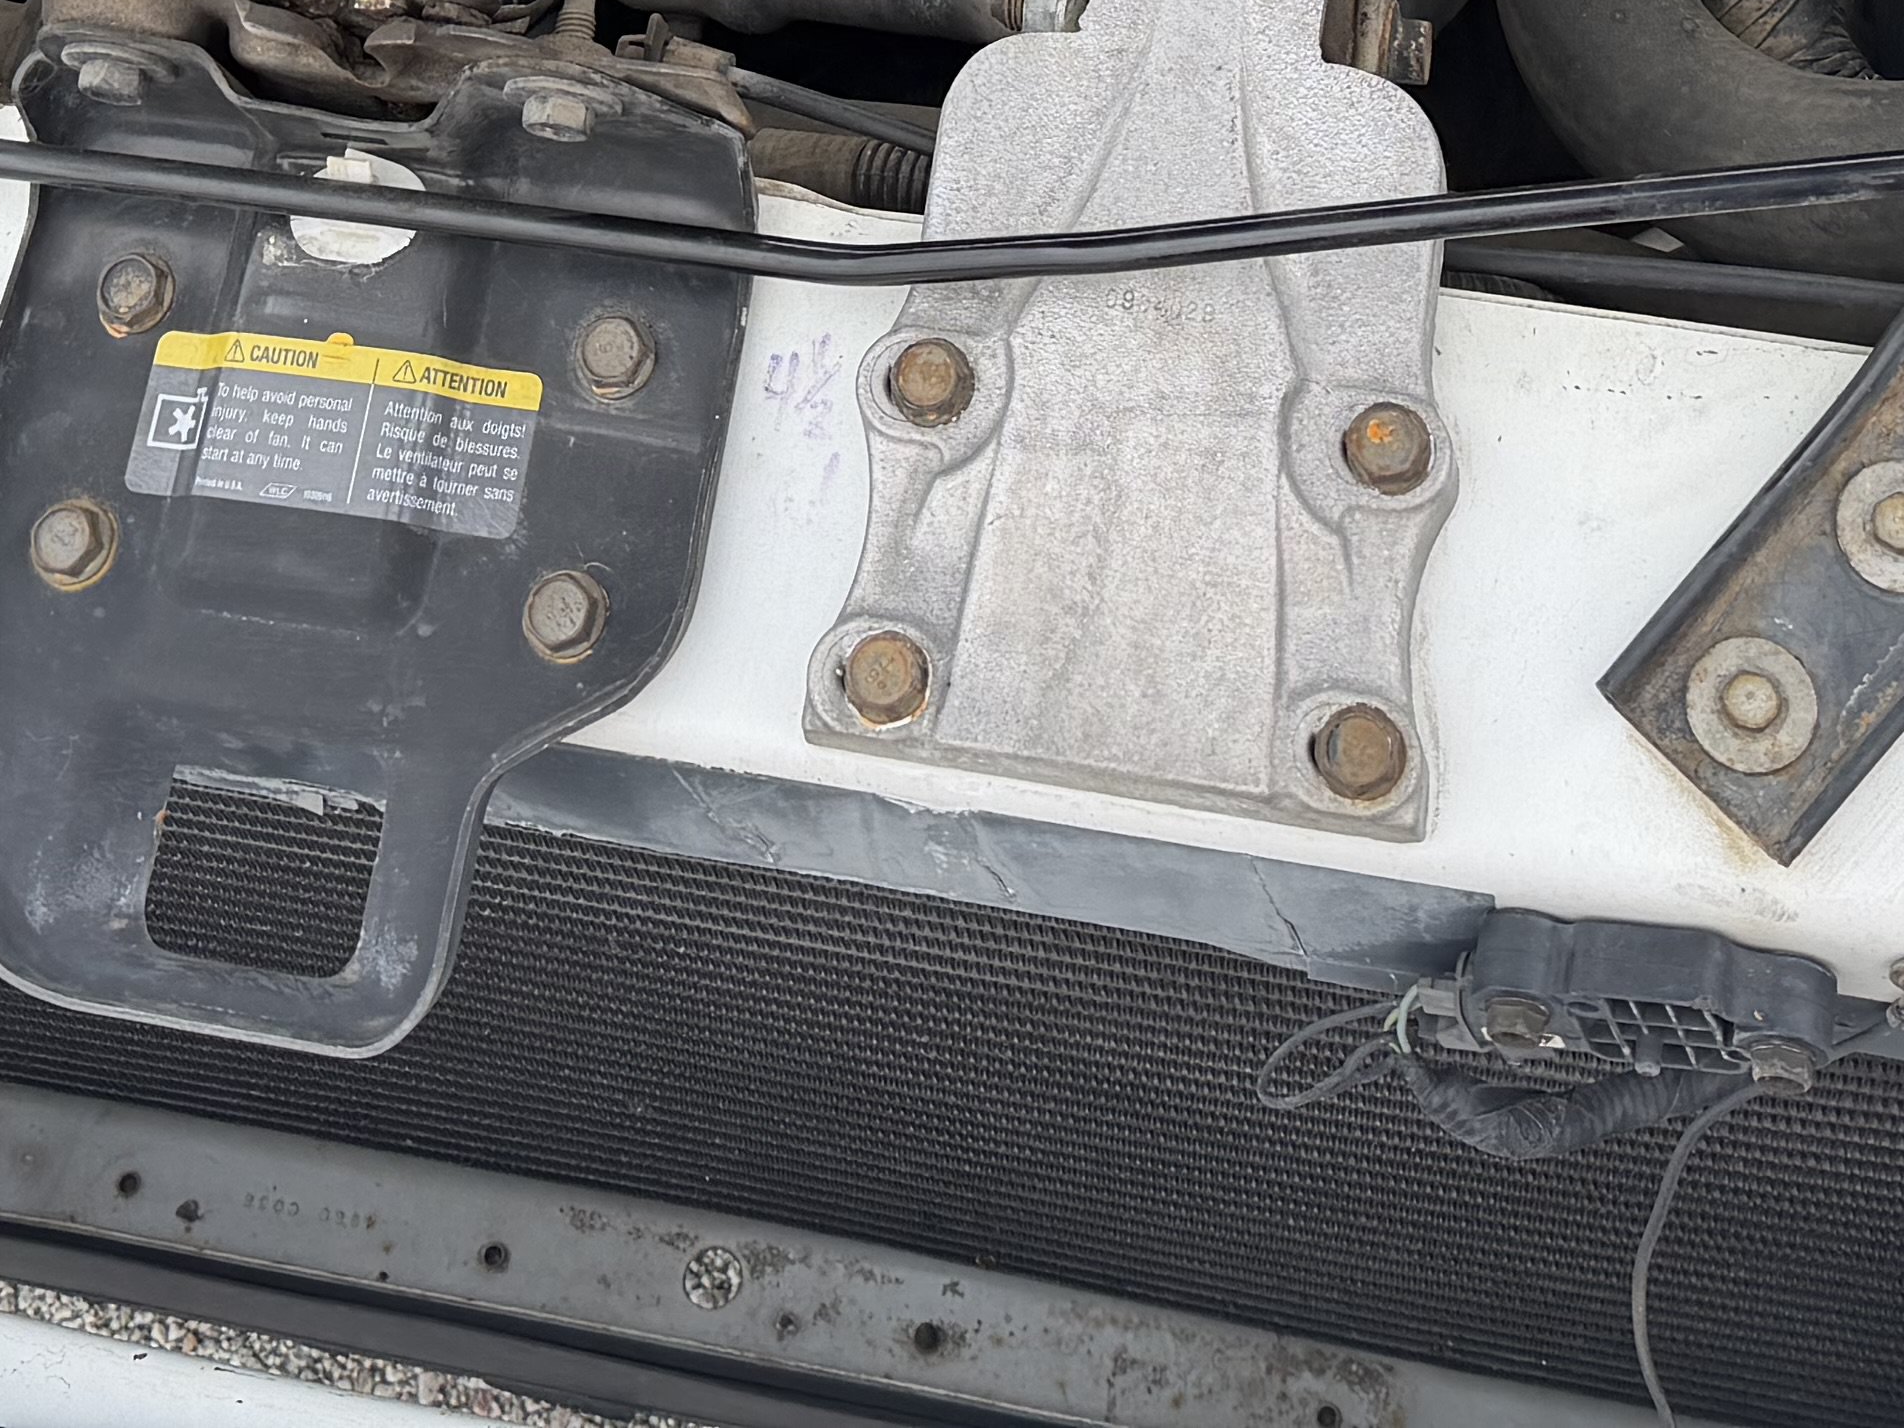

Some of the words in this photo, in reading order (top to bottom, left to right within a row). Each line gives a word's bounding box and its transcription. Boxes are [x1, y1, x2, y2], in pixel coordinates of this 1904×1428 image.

[248, 344, 319, 368] CAUTION
[216, 382, 229, 396] To
[231, 384, 259, 403] help
[261, 388, 296, 404] avoid
[298, 392, 353, 414] personal
[419, 366, 507, 398] ATTENTION
[261, 409, 294, 429] keep
[307, 414, 349, 432] hands
[384, 401, 443, 424] Attention
[450, 415, 474, 429] aux
[481, 417, 526, 441] doigts!
[206, 424, 237, 440] clear
[244, 428, 259, 443] of
[267, 431, 292, 447] fan.
[300, 435, 311, 449] It
[318, 440, 343, 453] can
[380, 422, 425, 446] Risque
[432, 430, 448, 446] de
[455, 434, 521, 459] blessures.
[200, 445, 228, 461] start
[230, 449, 244, 463] at
[245, 454, 270, 469] any
[272, 454, 304, 470] time.
[375, 443, 392, 459] Le
[397, 446, 464, 471] ventilateur
[468, 459, 497, 480] peut
[502, 468, 517, 480] se
[371, 465, 414, 485] mettre
[419, 473, 427, 487] à
[432, 475, 478, 496] tourner
[483, 487, 514, 502] sans
[366, 486, 459, 516] avertissement.
